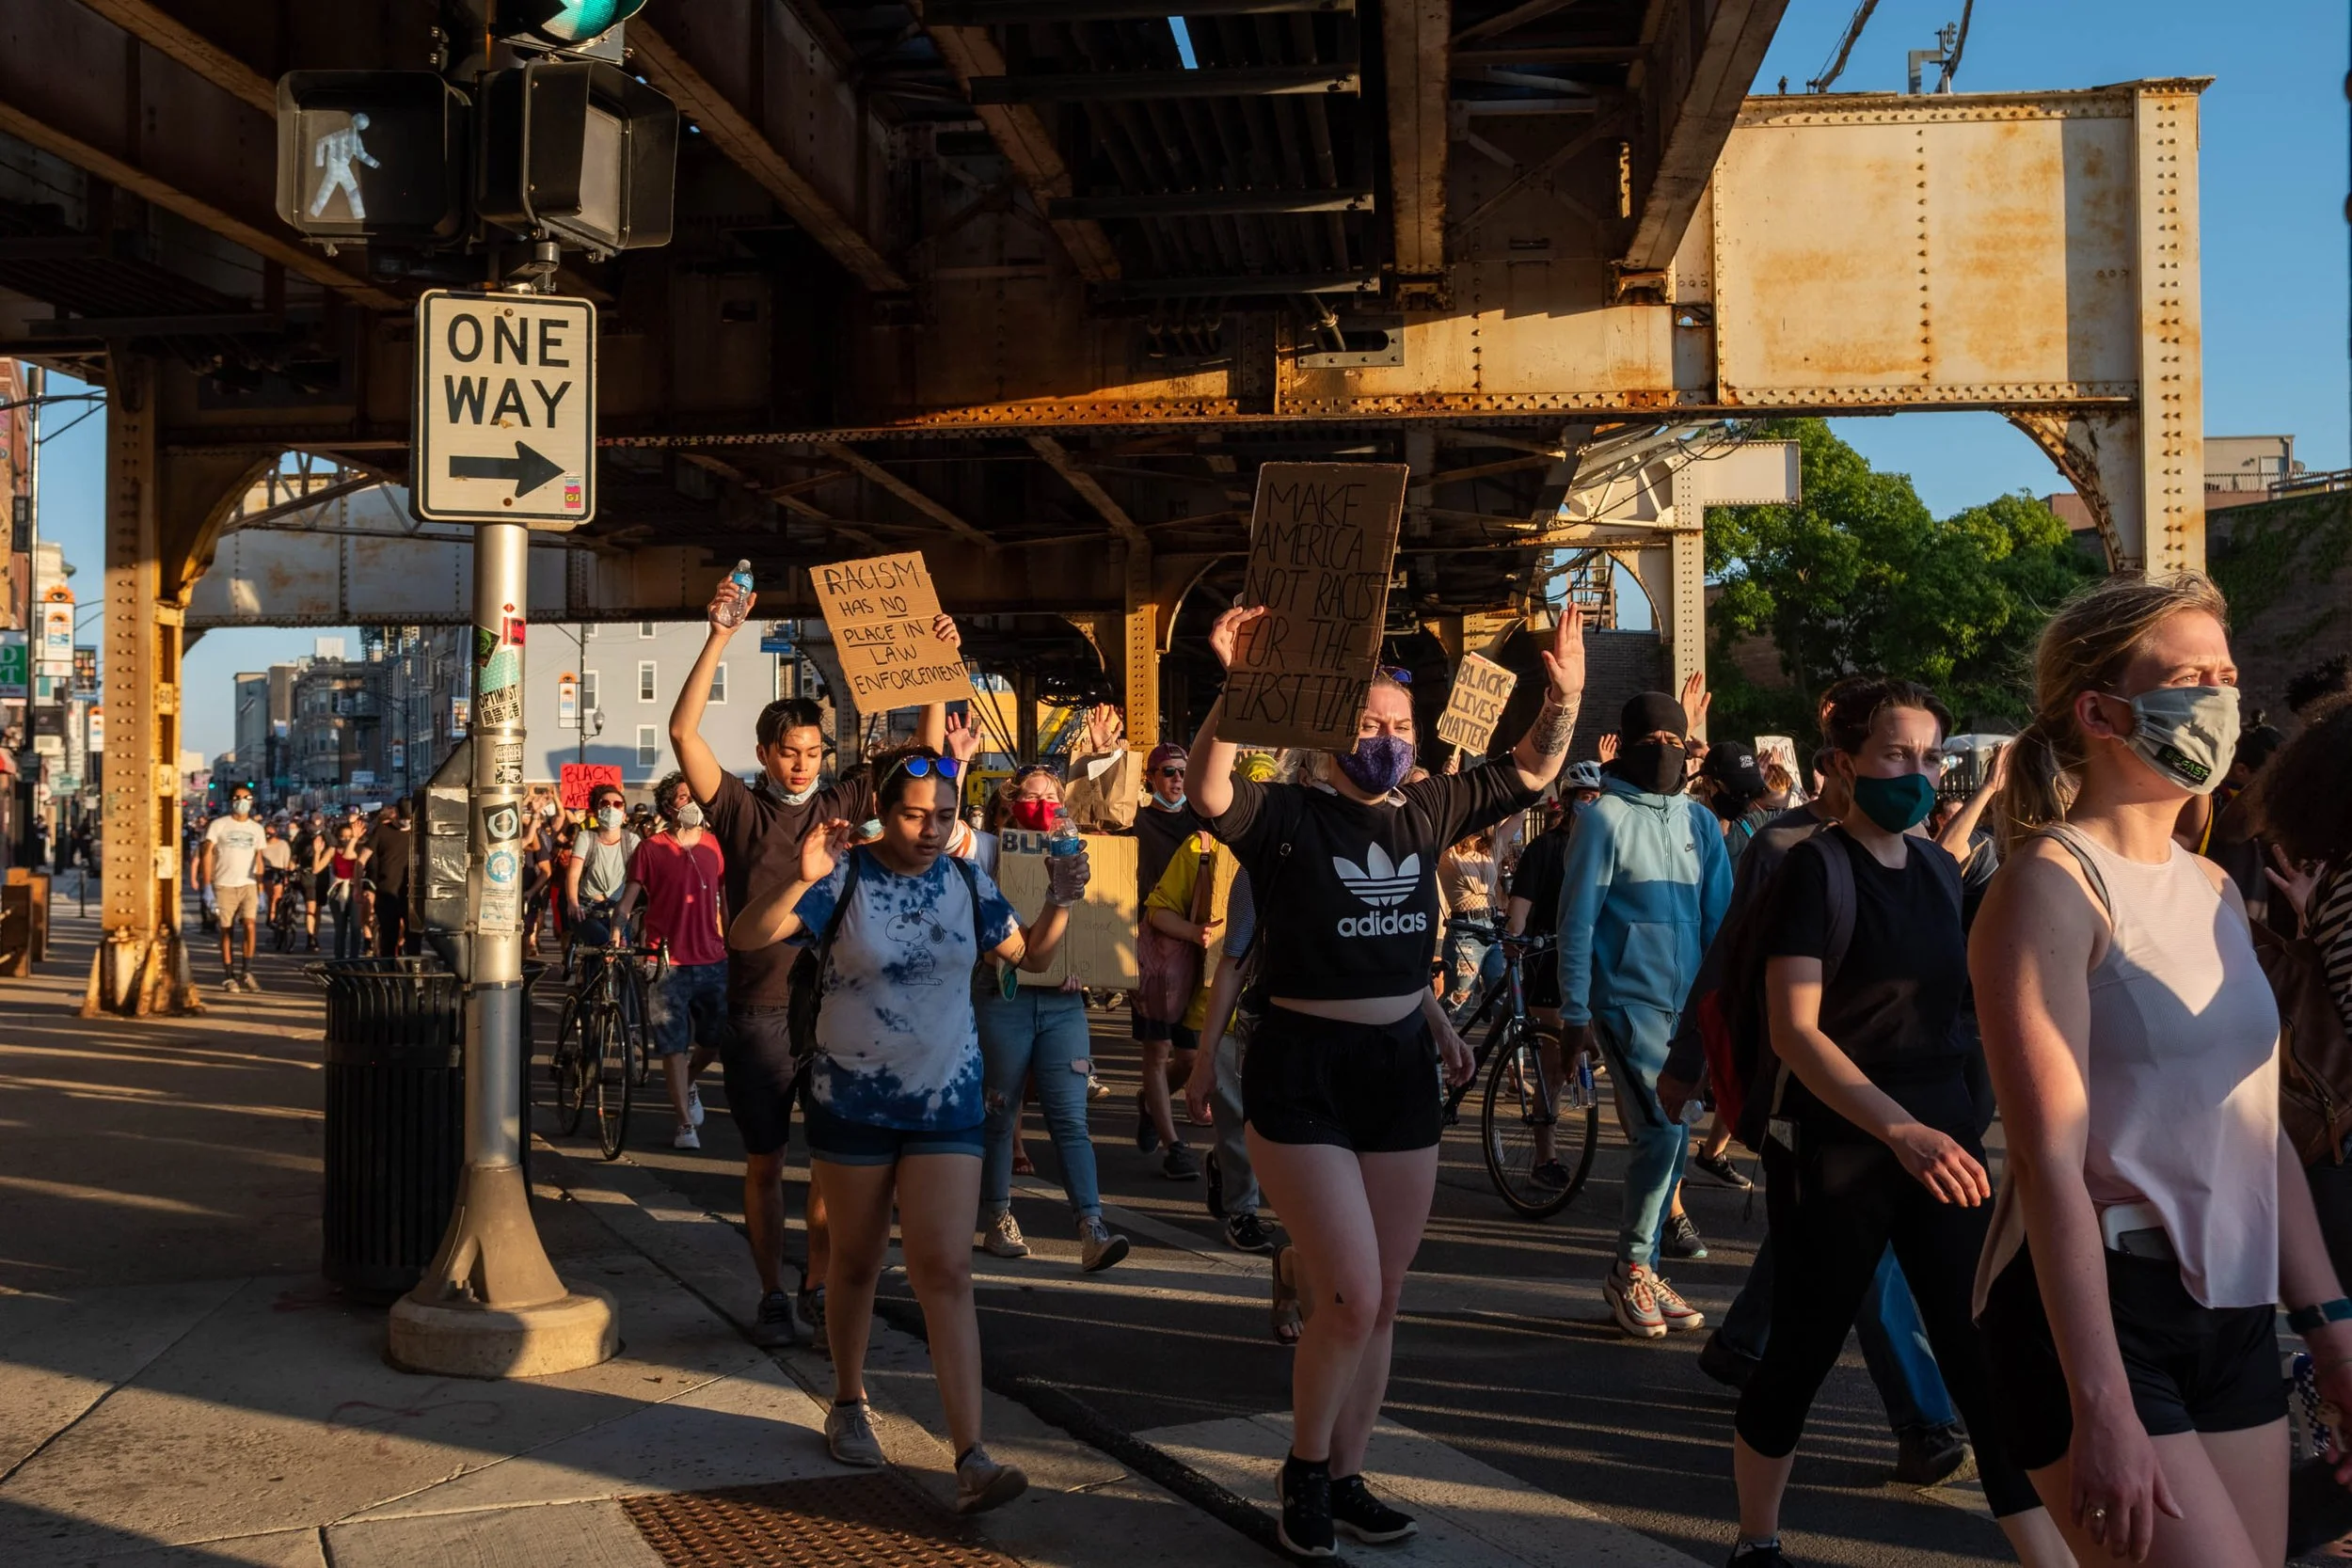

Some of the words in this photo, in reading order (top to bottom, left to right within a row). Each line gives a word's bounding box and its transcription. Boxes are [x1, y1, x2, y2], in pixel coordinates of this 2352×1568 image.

[448, 313, 569, 368] ONE
[444, 374, 572, 429] WAY
[1267, 482, 1367, 528] MAKE
[1251, 521, 1363, 571] AMERICA
[823, 560, 920, 594] RACISM
[1246, 565, 1309, 611] NOT
[1313, 571, 1390, 622] RACIST
[838, 597, 874, 616] HAS
[880, 595, 908, 613] NO
[843, 624, 896, 642] PLACE
[902, 619, 925, 639] IN
[1234, 615, 1289, 670] FOR
[1307, 619, 1360, 671] THE
[869, 643, 917, 666] LAW
[853, 661, 967, 695] ENFORCEMENT
[1455, 660, 1507, 698] BLACK
[1223, 671, 1311, 727] FIRST
[1312, 674, 1371, 737] TIME
[1451, 687, 1499, 724] LIVES
[1440, 712, 1489, 751] MATTER
[564, 766, 615, 784] BLACK
[1337, 909, 1427, 938] adidas
